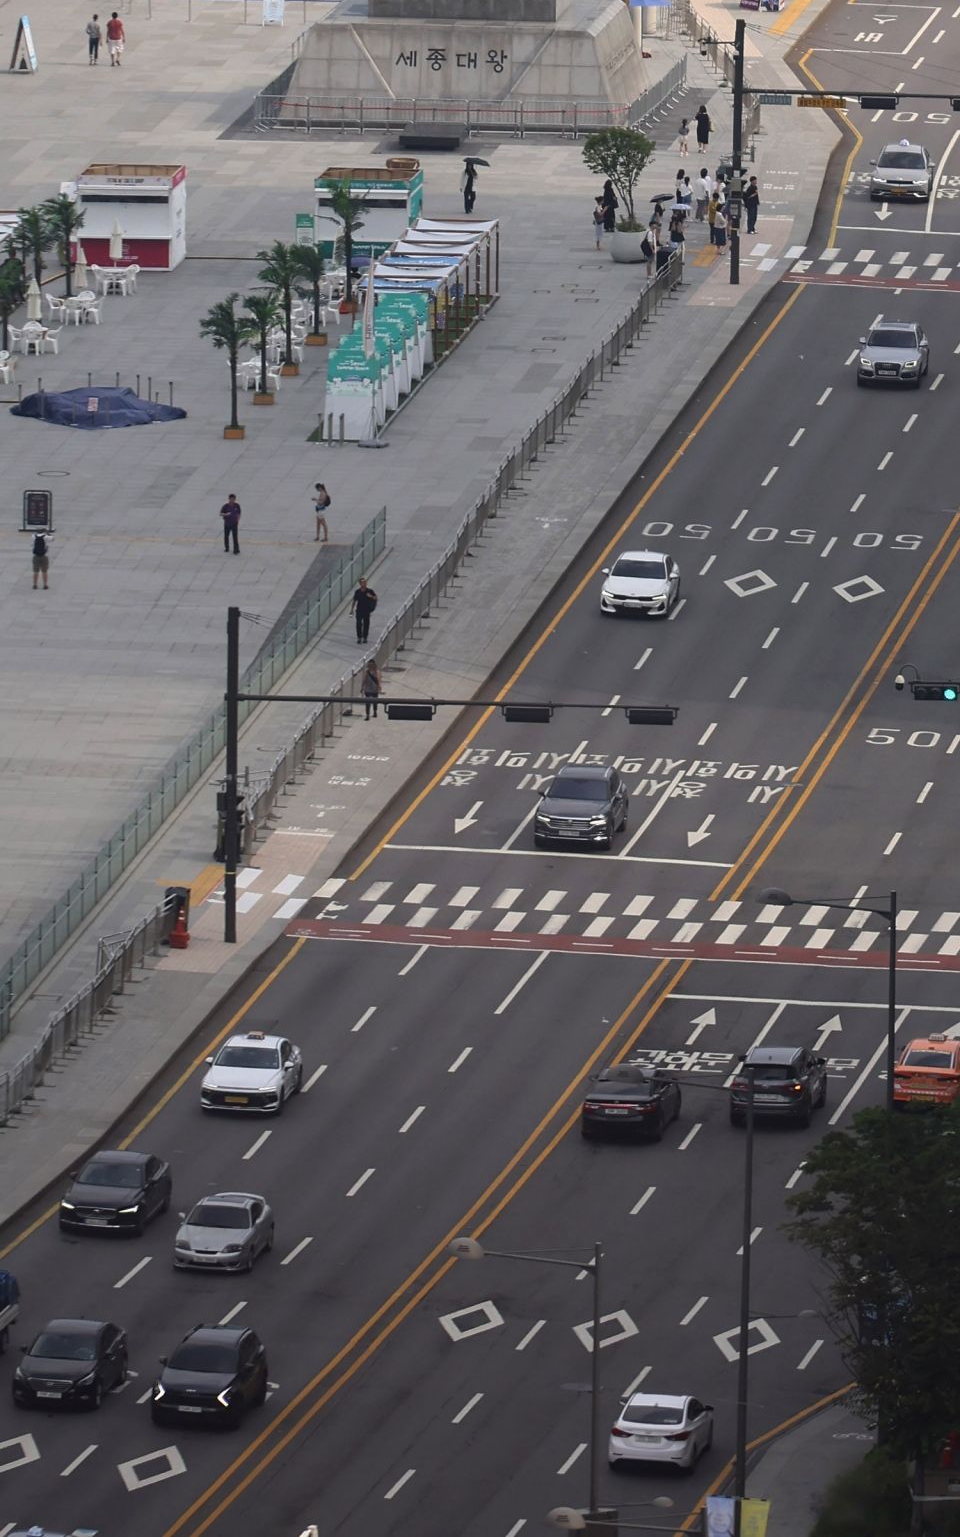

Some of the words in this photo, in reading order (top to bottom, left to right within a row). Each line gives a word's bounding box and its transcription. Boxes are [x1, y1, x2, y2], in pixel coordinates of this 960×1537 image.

[396, 48, 508, 73] 세종대왕
[891, 111, 952, 126] 50
[642, 521, 713, 540] 50
[747, 527, 817, 545] 50
[852, 532, 924, 550] 50
[865, 727, 941, 748] 50
